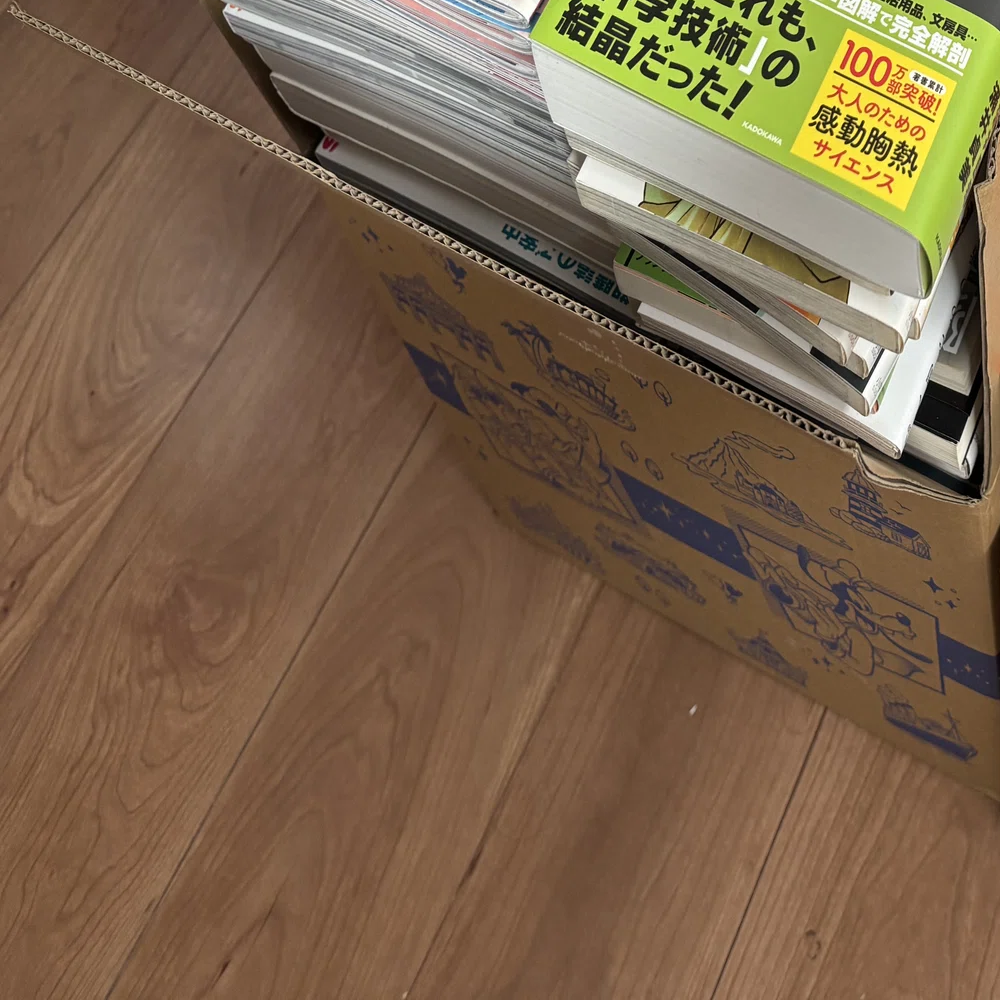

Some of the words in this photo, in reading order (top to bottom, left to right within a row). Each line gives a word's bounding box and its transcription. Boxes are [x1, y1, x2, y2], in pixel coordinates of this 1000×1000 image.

[835, 38, 895, 91] 100
[910, 71, 945, 95] 著書累計
[741, 118, 783, 146] KADOKAWA
[805, 99, 925, 180] 感動胸熱
[825, 79, 929, 144] 大人のための
[807, 135, 899, 195] サイエンス
